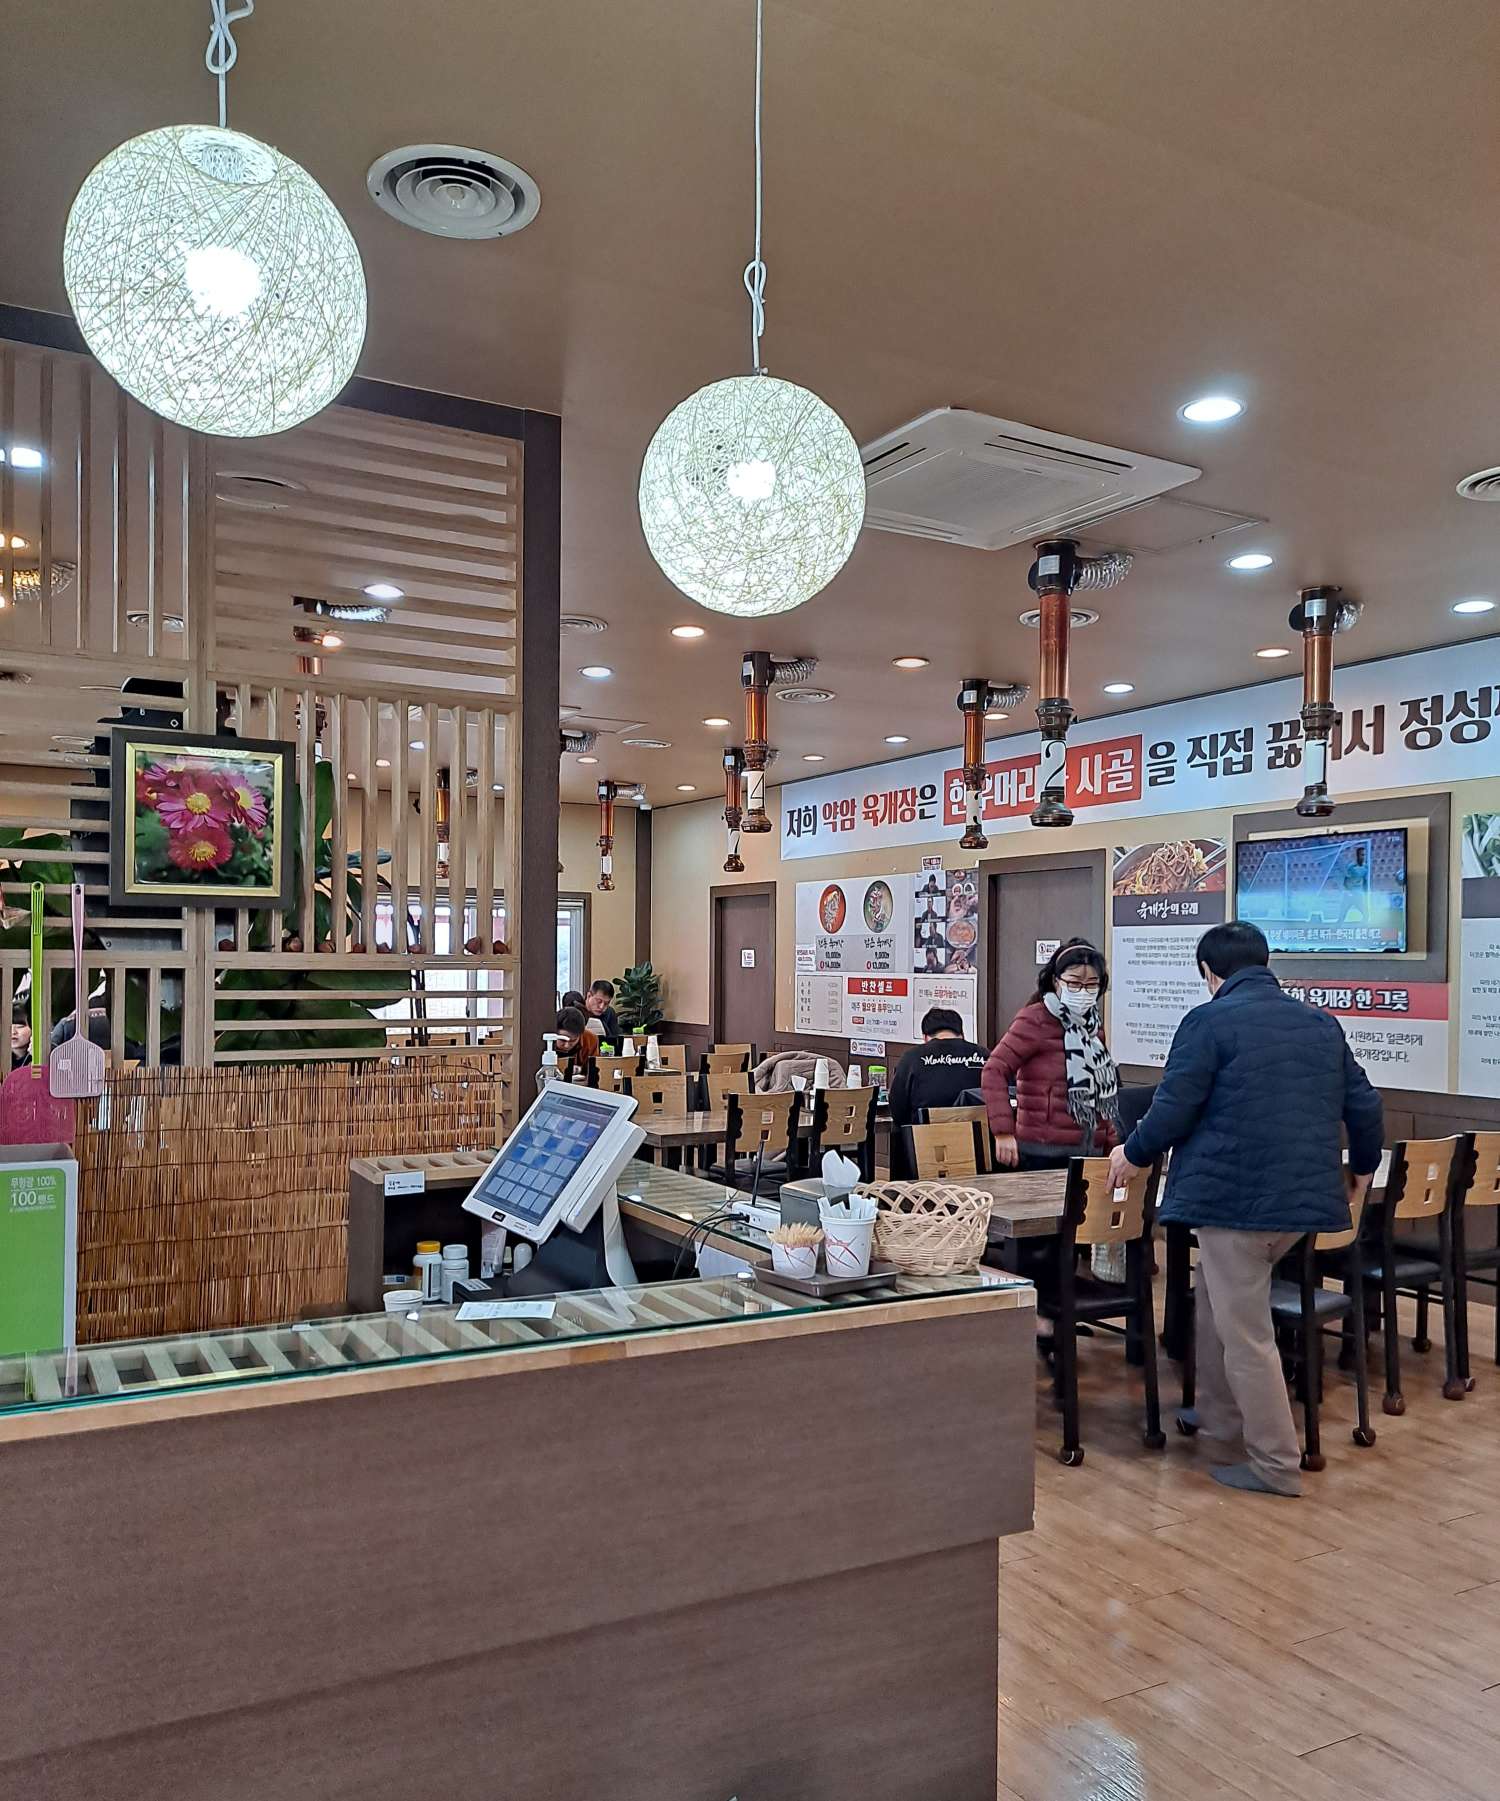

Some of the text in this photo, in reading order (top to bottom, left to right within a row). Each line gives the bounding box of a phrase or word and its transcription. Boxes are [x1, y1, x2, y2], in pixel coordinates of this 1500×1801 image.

[786, 805, 818, 838] 저희
[822, 800, 857, 833] 약암
[862, 784, 938, 827] 육개장은
[1187, 728, 1254, 778] 직접
[1400, 685, 1500, 751] 정성
[1045, 740, 1067, 791] 2
[751, 772, 765, 809] 4
[1137, 899, 1199, 920] 육개장의 유래
[861, 980, 893, 994] 반찬셀프
[1309, 987, 1352, 1009] 육개장
[1355, 988, 1372, 1009] 한
[1375, 989, 1409, 1011] 그릇
[1350, 1031, 1423, 1046] 시원하고 얼큰하게
